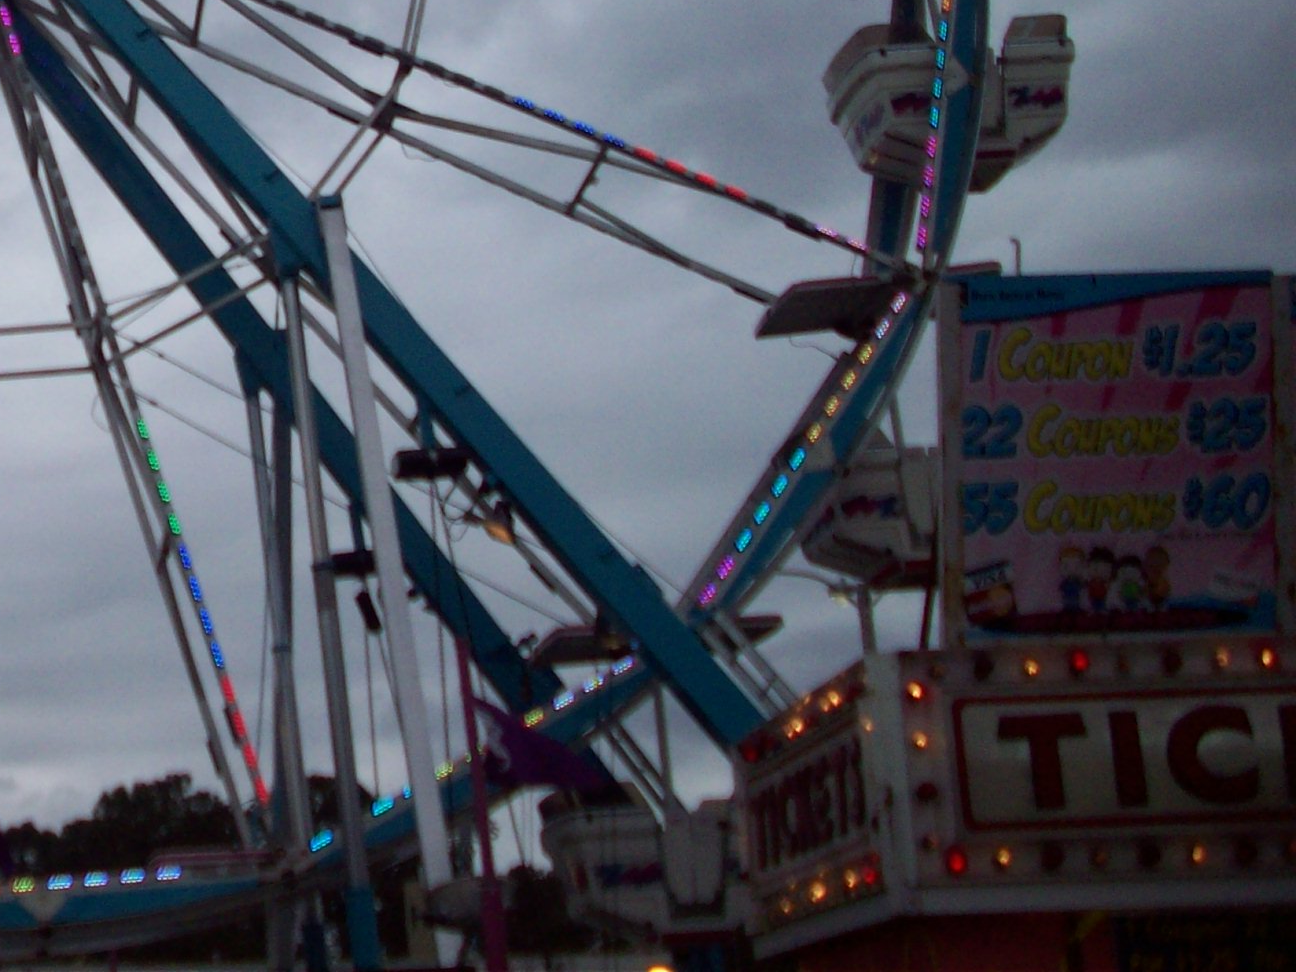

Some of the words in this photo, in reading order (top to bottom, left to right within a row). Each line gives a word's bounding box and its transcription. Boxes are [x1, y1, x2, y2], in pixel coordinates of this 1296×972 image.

[971, 331, 991, 382] 1
[999, 329, 1134, 382] COUPON
[1145, 323, 1257, 376] $1.25
[963, 405, 1022, 458] 22
[1027, 404, 1180, 457] COUPONS
[1188, 399, 1266, 453] $25
[963, 482, 1019, 533] 55
[1025, 481, 1176, 533] COUPONS
[1183, 474, 1271, 529] $60
[997, 705, 1296, 811] TIC
[751, 737, 865, 869] TICKETS
